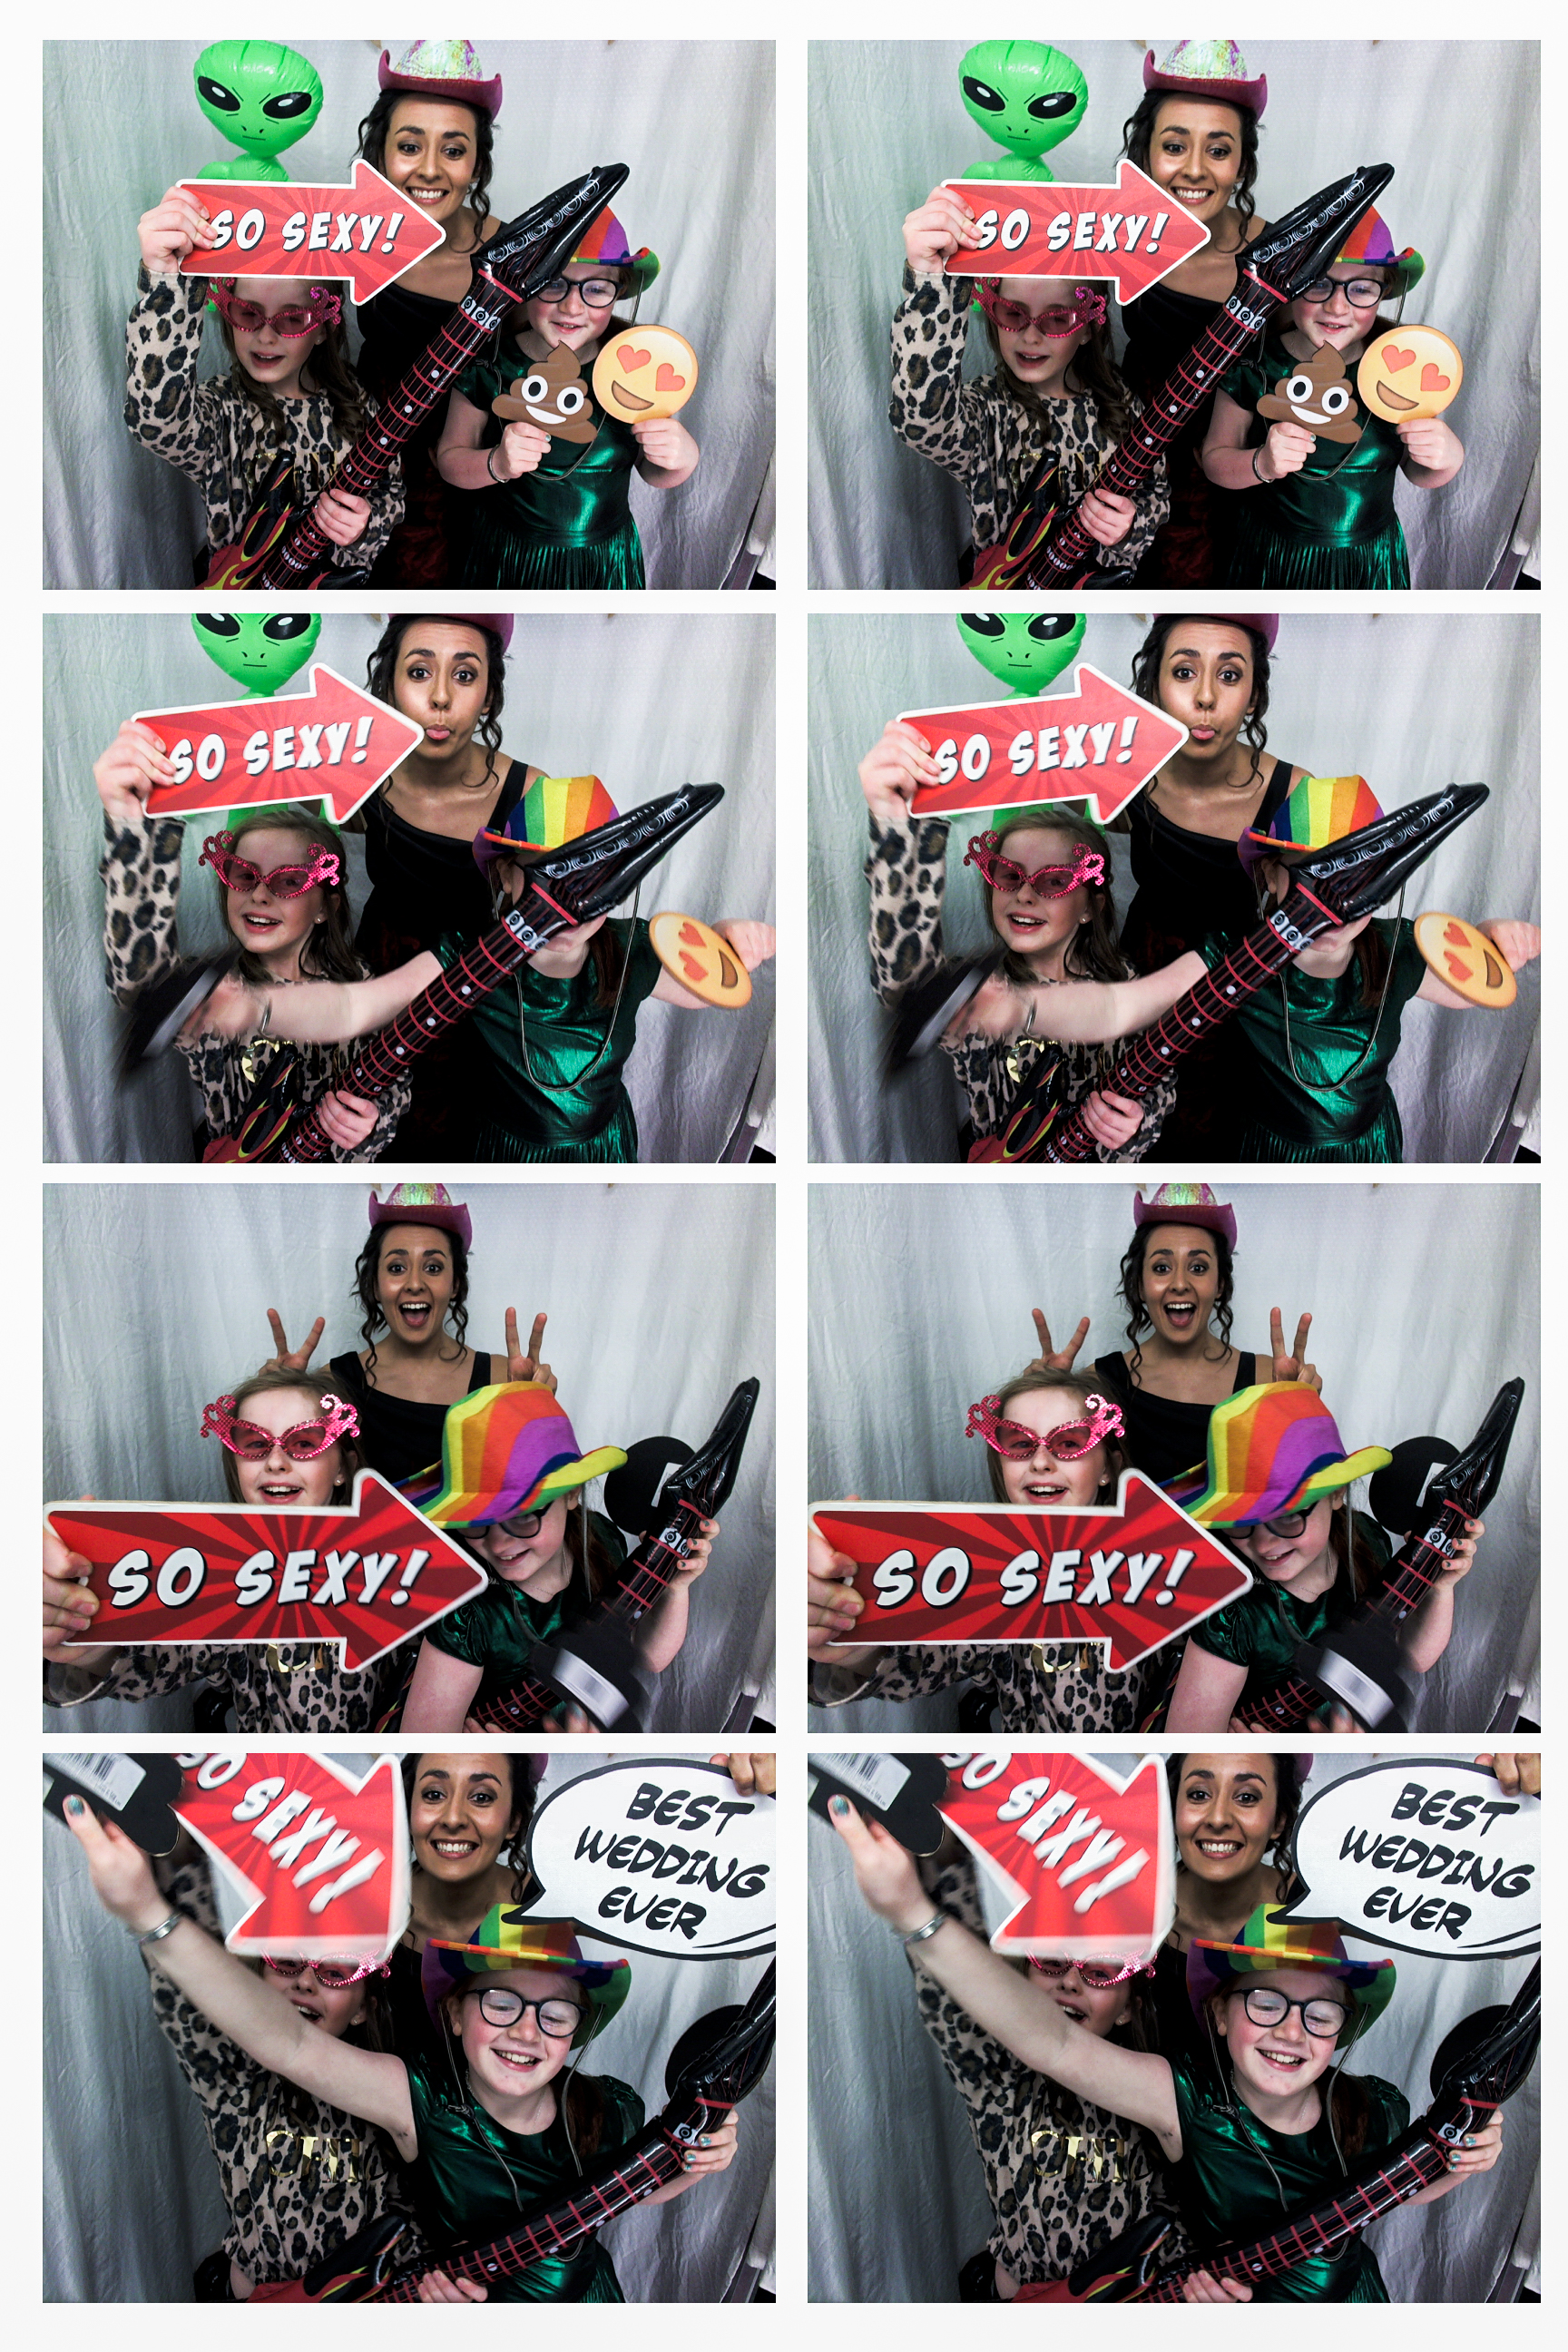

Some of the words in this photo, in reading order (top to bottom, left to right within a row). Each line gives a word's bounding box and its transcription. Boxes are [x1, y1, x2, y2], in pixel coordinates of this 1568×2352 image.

[209, 208, 266, 251] SO
[281, 211, 405, 254] SEXY!
[974, 208, 1031, 251] SO
[1046, 211, 1170, 254] SEXY!
[169, 733, 226, 785] SO
[242, 715, 374, 777] SEXY!
[934, 733, 991, 785] SO
[1007, 715, 1139, 777] SEXY!
[107, 1546, 208, 1608] SO
[234, 1548, 431, 1607] SEXY!
[872, 1546, 973, 1608] SO
[999, 1548, 1196, 1607] SEXY!
[626, 1782, 755, 1837] BEST
[1391, 1782, 1520, 1837] BEST
[231, 1776, 386, 1914] SEXY!
[573, 1825, 770, 1898] WEDDING
[996, 1776, 1151, 1914] SEXY!
[1338, 1825, 1535, 1898] WEDDING
[598, 1886, 707, 1940] EVER
[1363, 1886, 1472, 1940] EVER
